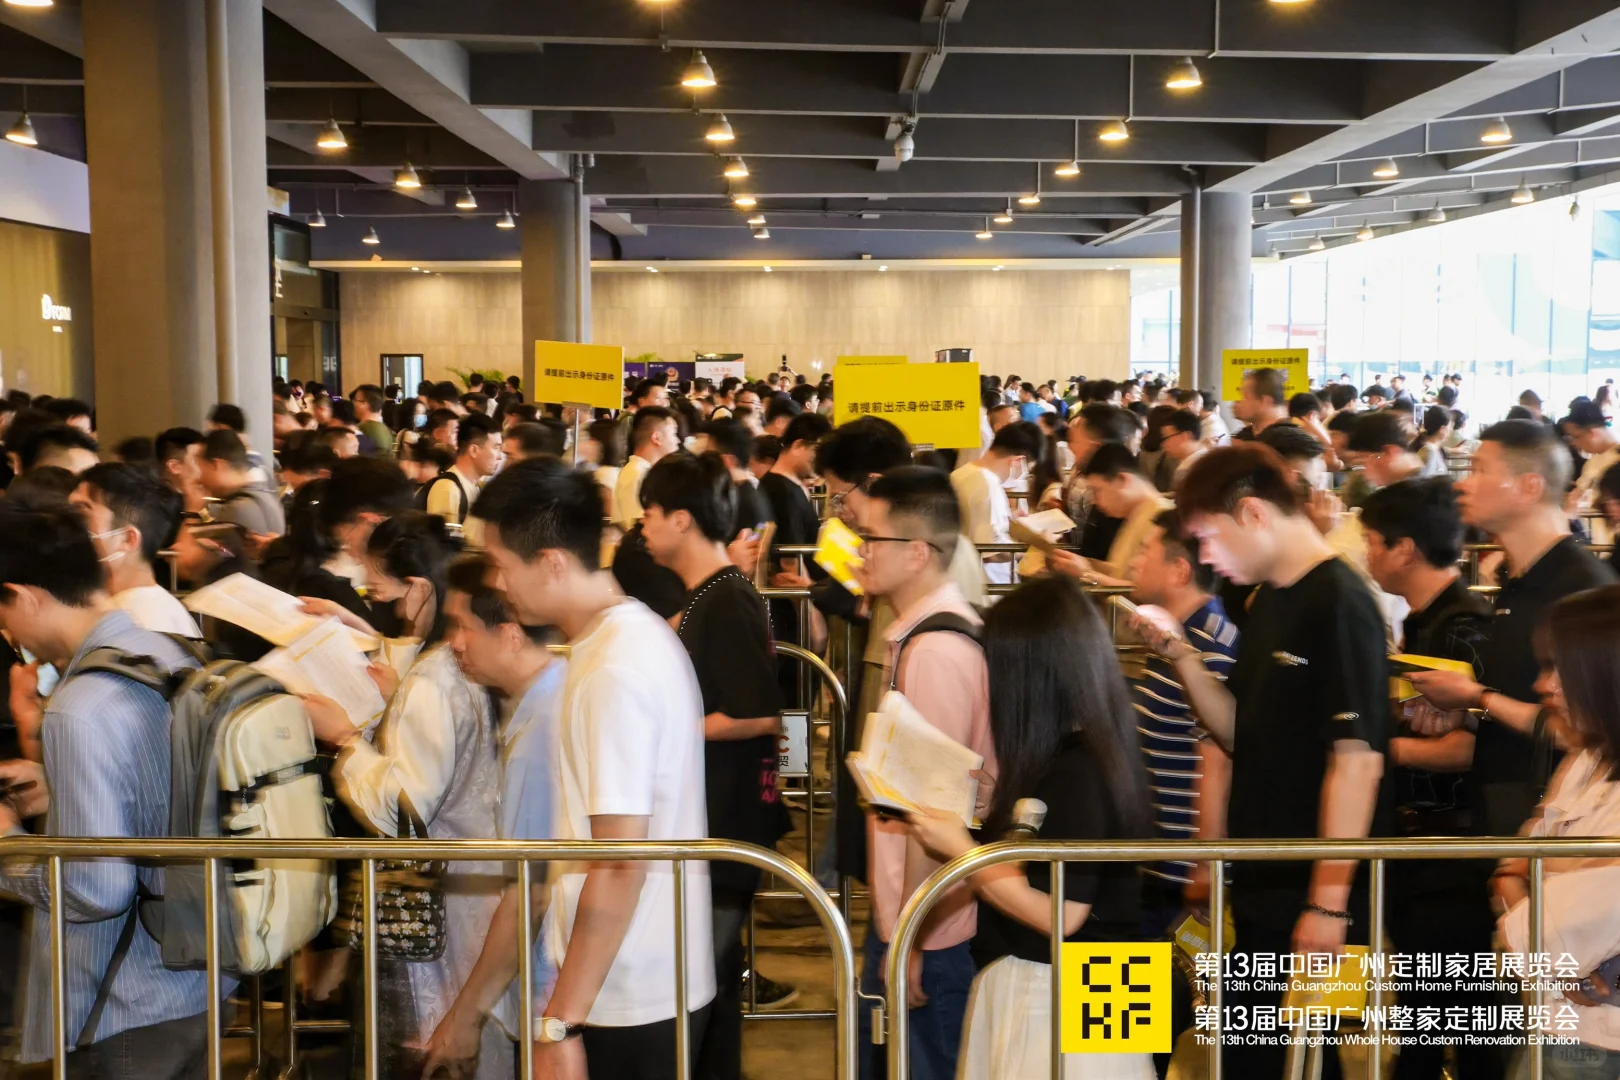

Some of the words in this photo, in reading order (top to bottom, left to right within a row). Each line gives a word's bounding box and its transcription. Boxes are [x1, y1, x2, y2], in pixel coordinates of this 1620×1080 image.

[848, 400, 966, 414] 请提前出示身份证原件
